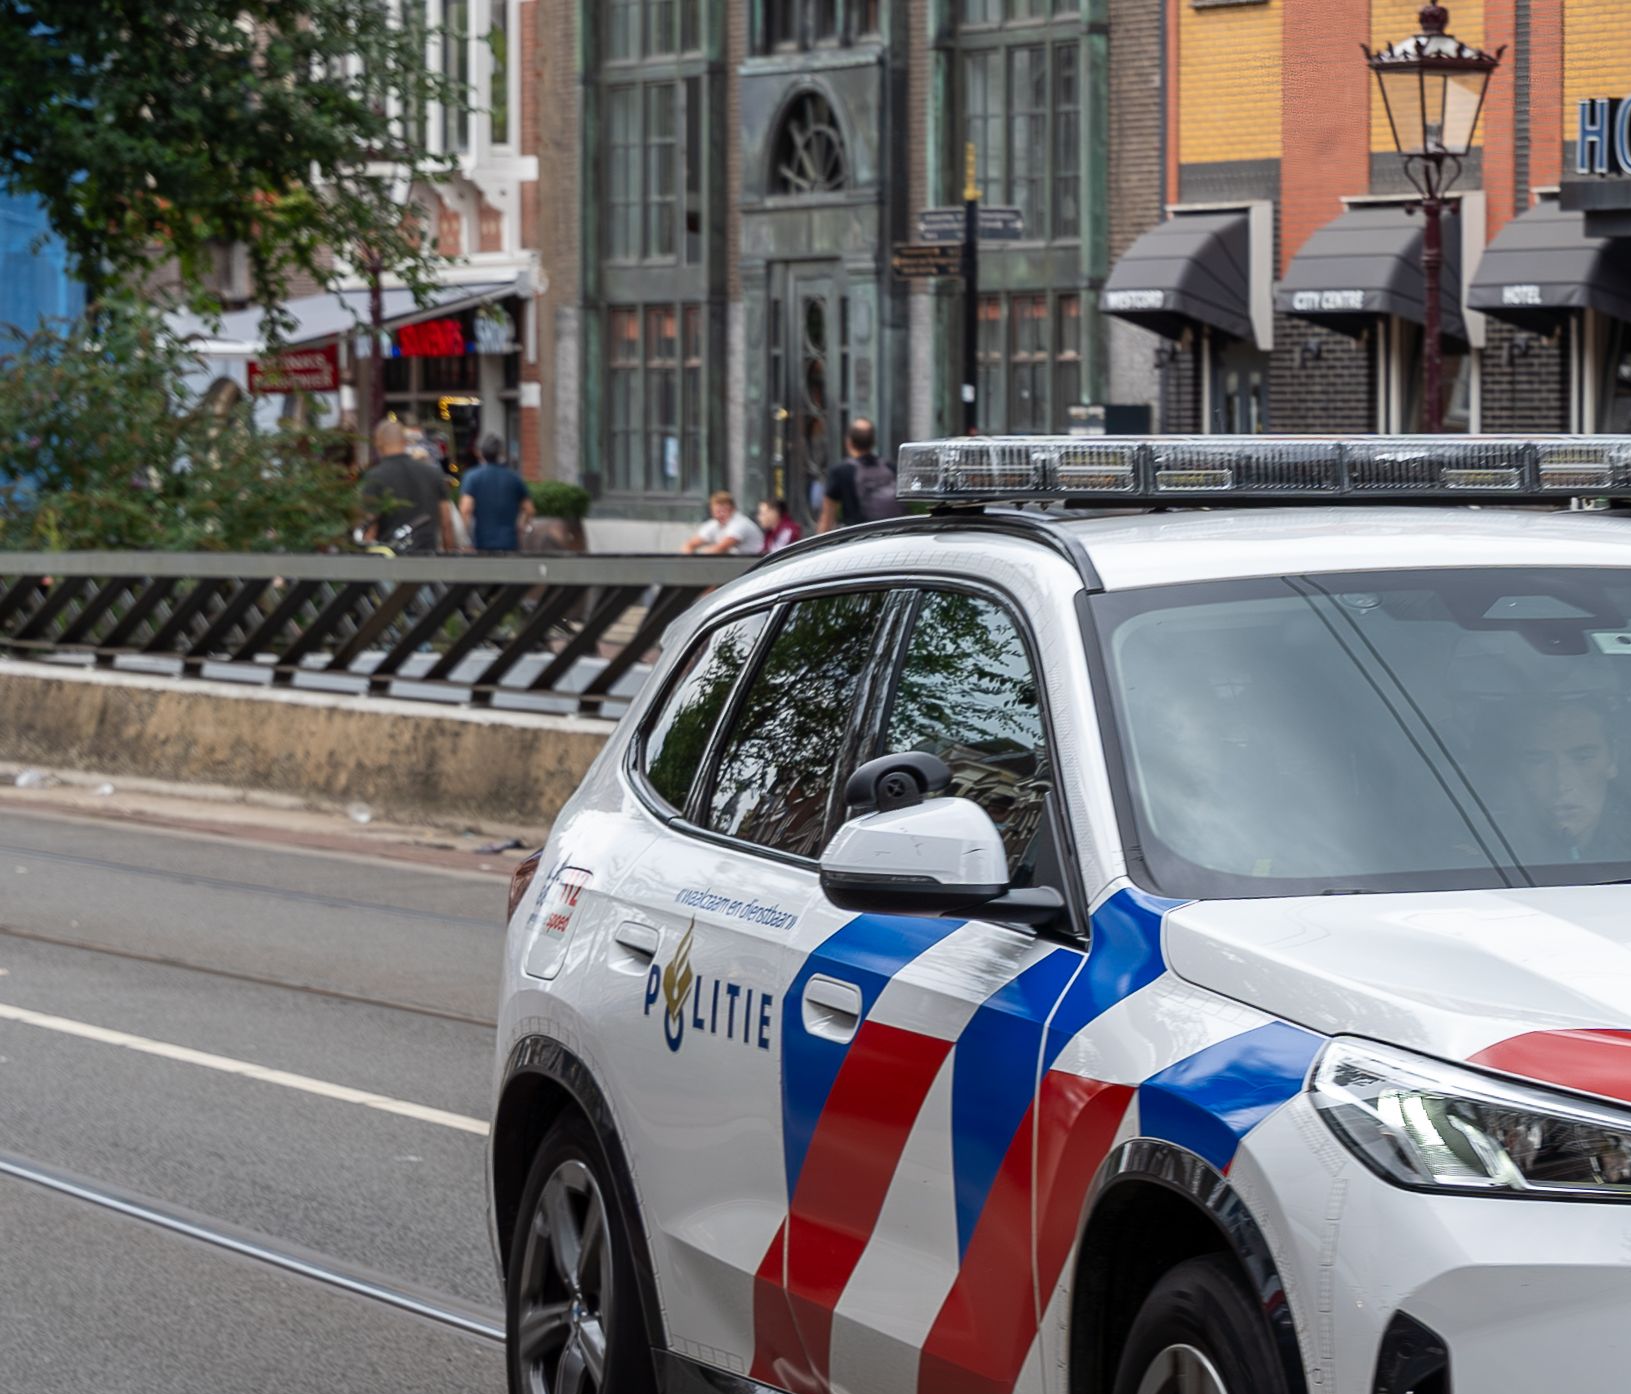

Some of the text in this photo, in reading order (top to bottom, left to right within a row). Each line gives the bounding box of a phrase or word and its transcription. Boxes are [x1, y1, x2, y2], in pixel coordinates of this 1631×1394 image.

[1292, 289, 1365, 310] CITY CENTRE
[1502, 285, 1542, 305] HOTEL
[644, 963, 774, 1053] POLITIE
